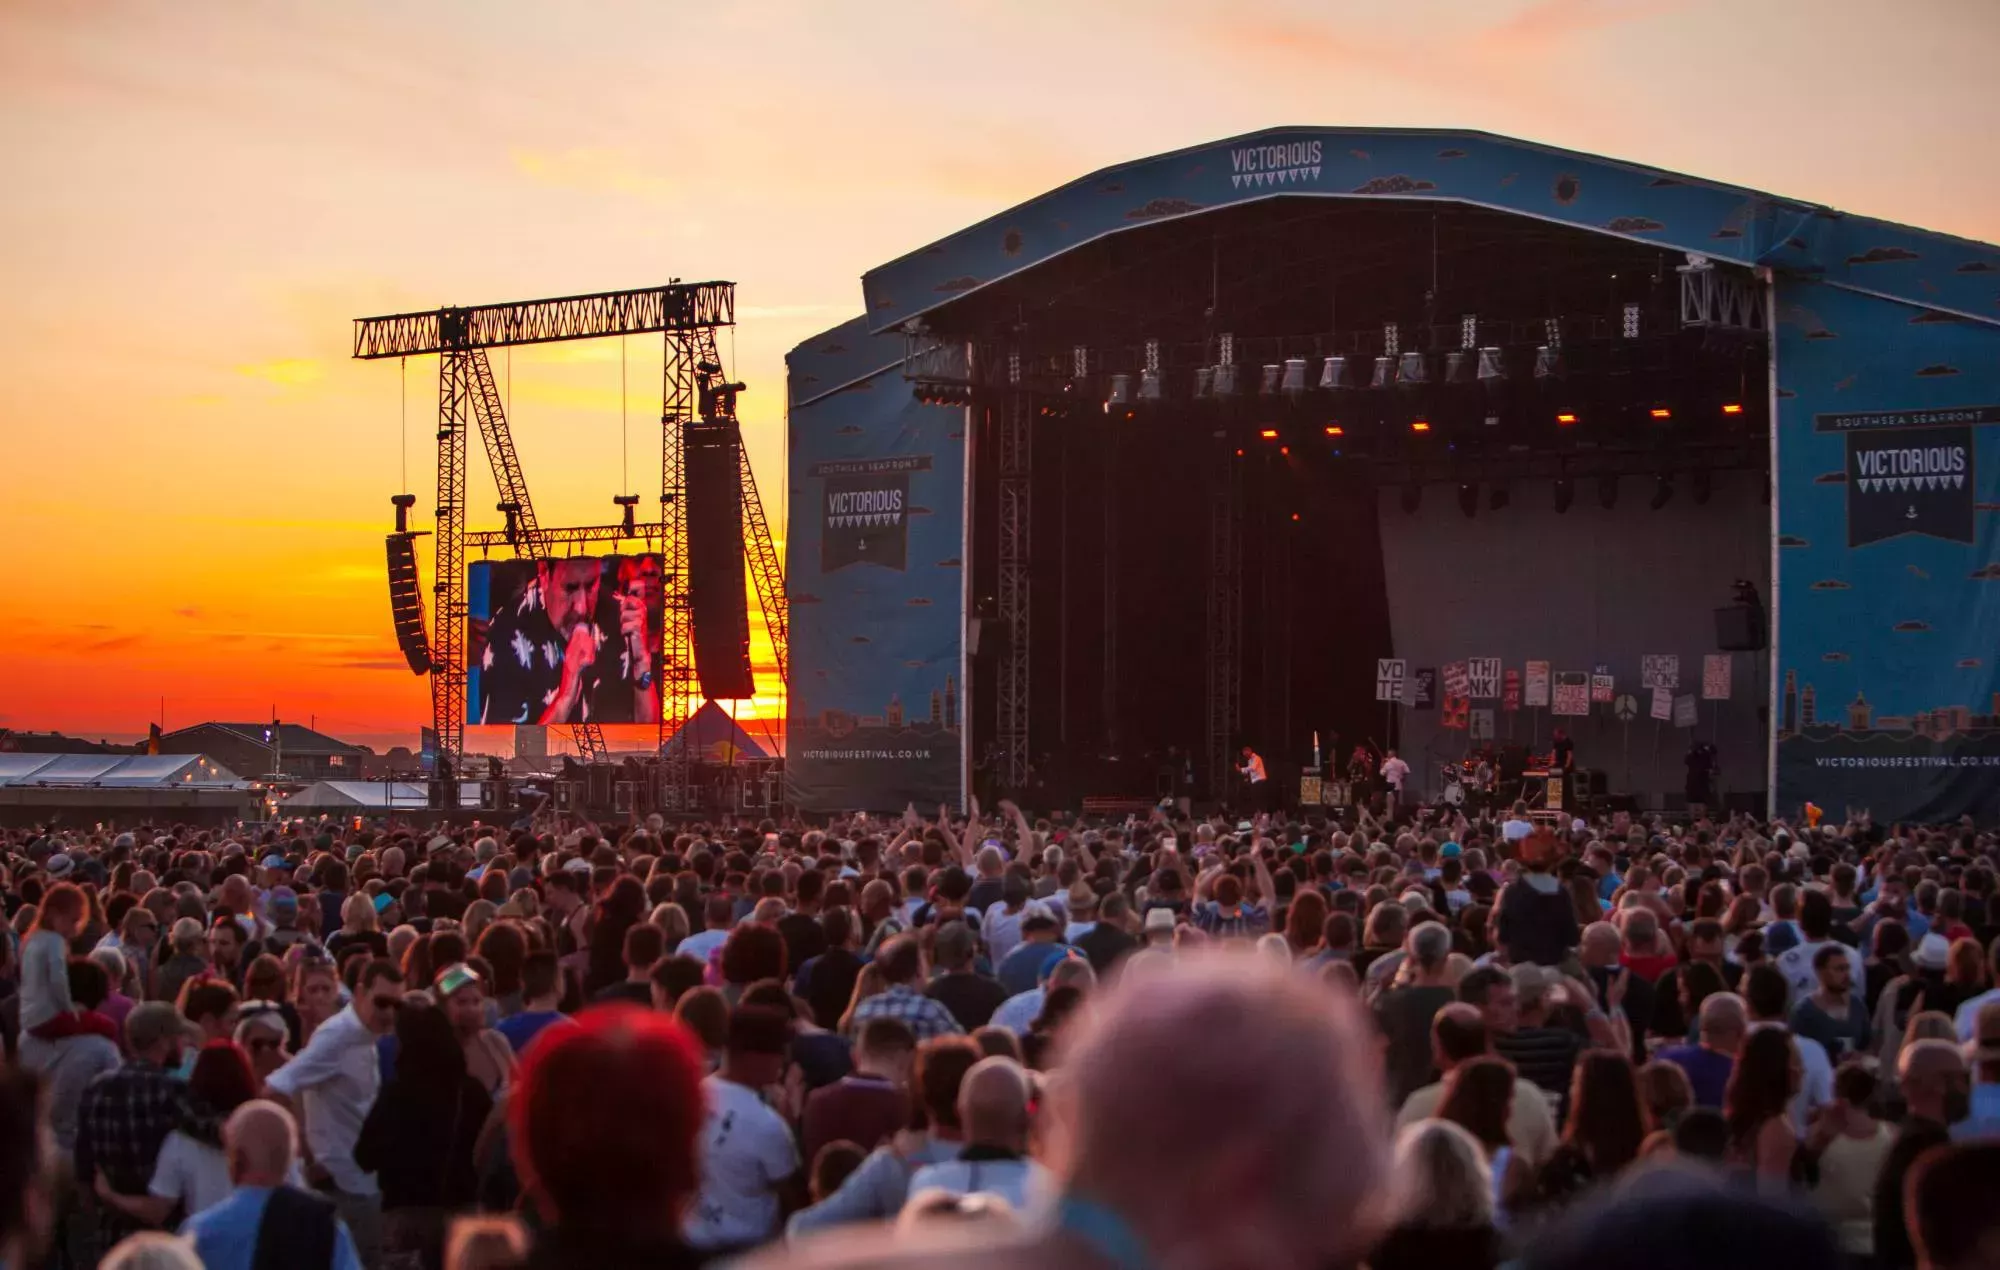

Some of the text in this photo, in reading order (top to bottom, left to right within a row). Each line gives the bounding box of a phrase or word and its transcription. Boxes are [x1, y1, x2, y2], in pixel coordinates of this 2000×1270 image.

[1231, 140, 1322, 172] VICTORIOUS
[1835, 411, 1983, 427] SOUTHSEA SEAFRONT
[1856, 446, 1966, 476] VICTORIOUS
[828, 489, 902, 514] VICTORIOUS
[803, 750, 931, 759] VICTORIOUSFESTIVAL.CO.UK
